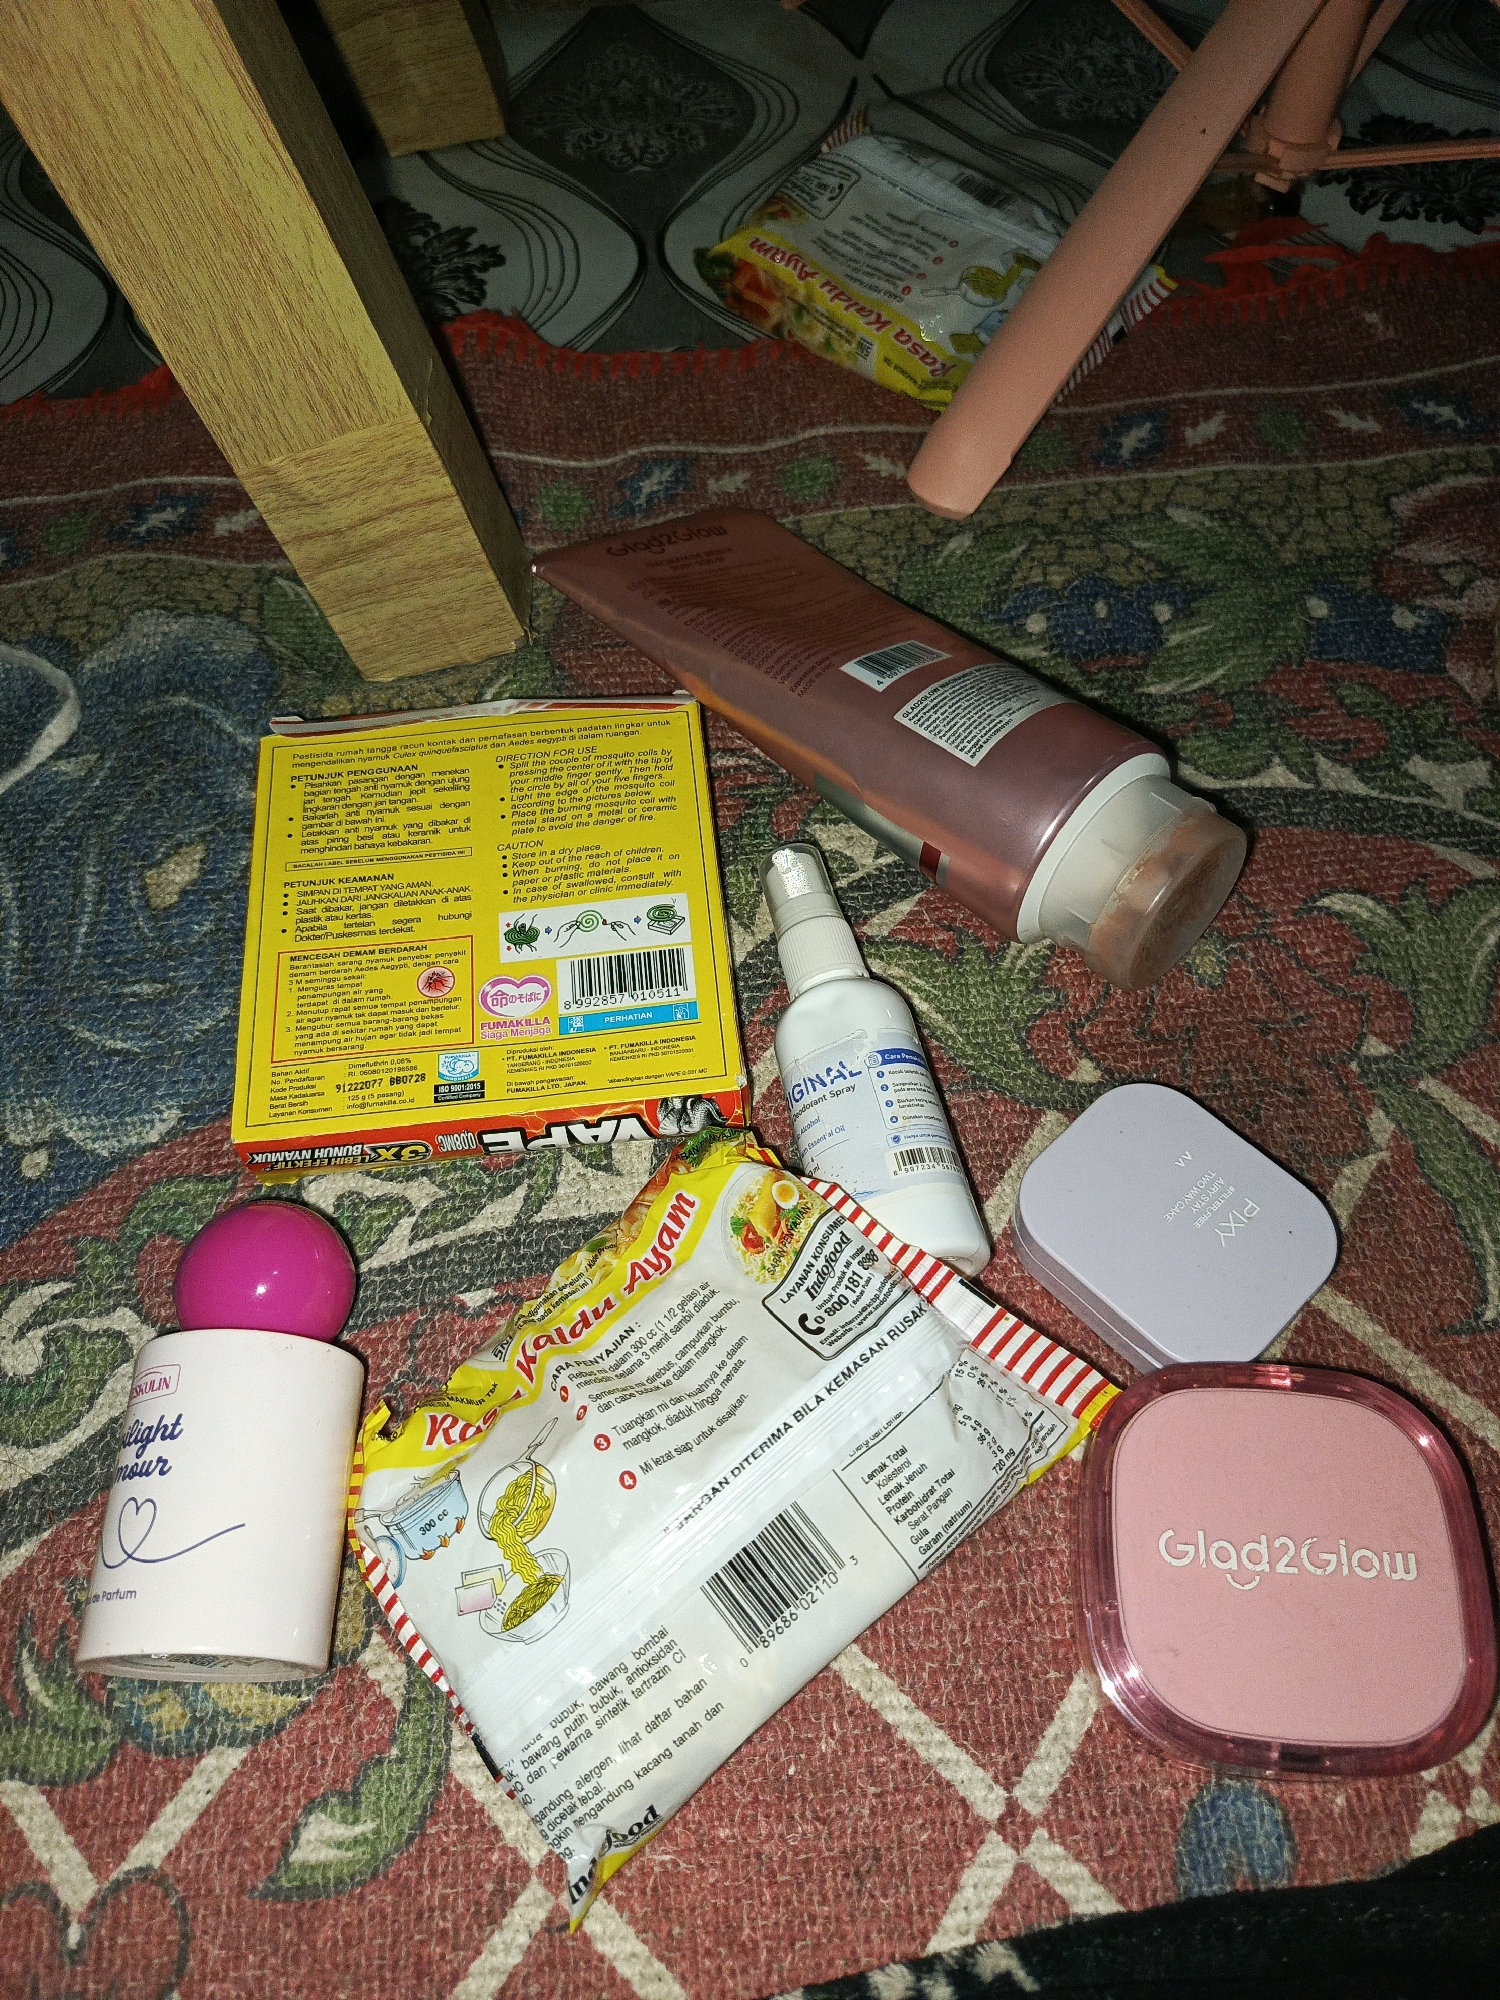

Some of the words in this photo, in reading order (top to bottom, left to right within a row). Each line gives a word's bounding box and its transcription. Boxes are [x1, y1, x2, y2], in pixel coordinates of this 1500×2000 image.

[496, 751, 550, 762] DIRECTION
[553, 748, 574, 756] FOR
[578, 746, 597, 754] USE
[510, 761, 529, 769] Split
[549, 756, 579, 764] couple
[594, 752, 634, 760] mosquito
[661, 748, 672, 756] by
[291, 771, 344, 782] PETUNJUK
[347, 764, 418, 778] PENGGUNAAN
[497, 840, 543, 851] CAUTION
[512, 851, 536, 860] Store
[559, 847, 573, 855] dry
[576, 844, 602, 854] place.
[284, 878, 335, 888] PETUNJUK
[338, 873, 394, 884] KEAMANAN
[290, 949, 341, 962] MENCEGAH
[342, 949, 376, 958] DEMAM
[378, 945, 427, 956] BERDARAH
[564, 1001, 570, 1010] 8
[576, 994, 625, 1008] 992857
[632, 988, 681, 1001] 010511
[480, 1017, 551, 1031] FUMAKILLA
[604, 1012, 653, 1023] PERHATIAN
[480, 1029, 508, 1040] Siaga
[511, 1026, 551, 1038] Menjaga
[520, 1051, 558, 1061] FUMAKILLA
[560, 1047, 596, 1057] INDONESIA
[438, 1084, 448, 1093] ISO
[450, 1082, 481, 1092] 9001:2015
[786, 1061, 862, 1112] IGINAL
[829, 1084, 856, 1098] Spray
[480, 1116, 652, 1154] VAPE
[835, 1125, 845, 1135] Oil
[253, 1151, 309, 1163] NYAMUK
[314, 1144, 363, 1158] BUNUH
[1198, 1170, 1216, 1190] TWO
[1208, 1176, 1225, 1196] AIRY
[1183, 1187, 1199, 1205] WAY
[1190, 1194, 1209, 1215] STAY
[1163, 1201, 1184, 1223] CAKE
[1214, 1198, 1261, 1247] PIXY
[624, 1192, 696, 1294] Ayam
[767, 1246, 787, 1276] SARAN
[804, 1230, 852, 1302] Indofood
[780, 1261, 815, 1304] LAYANAN
[825, 1294, 850, 1316] 800
[845, 1271, 864, 1294] 181
[516, 1296, 616, 1383] Kaldu
[568, 1370, 596, 1382] Rebus
[597, 1367, 608, 1375] mi
[608, 1351, 633, 1372] dalam
[630, 1336, 648, 1353] 300
[646, 1328, 658, 1340] cc
[663, 1307, 678, 1322] 1/2
[677, 1289, 701, 1315] gelas)
[700, 1281, 711, 1291] air
[576, 1375, 614, 1389] mendidih
[616, 1360, 645, 1380] selama
[642, 1352, 650, 1360] 3
[649, 1334, 672, 1357] menit
[669, 1310, 696, 1335] sambil
[693, 1289, 720, 1314] diaduk.
[551, 1361, 574, 1391] CARA
[575, 1326, 636, 1368] PENYAJIAN
[588, 1384, 635, 1402] Sementara
[645, 1359, 678, 1385] direbus,
[675, 1326, 712, 1362] campurkan
[712, 1298, 740, 1323] bumbu,
[611, 1409, 659, 1437] Tuangkan
[657, 1403, 670, 1413] mi
[669, 1393, 687, 1406] dan
[687, 1370, 720, 1397] kuahnya
[717, 1360, 728, 1372] ke
[726, 1334, 749, 1364] dalam
[730, 1421, 793, 1479] DITERIMA
[792, 1394, 826, 1423] BILA
[824, 1338, 889, 1396] KEMASAN
[887, 1302, 928, 1342] RUSAK
[639, 1461, 653, 1475] Mi
[653, 1449, 675, 1467] lezat
[675, 1437, 693, 1456] siap
[693, 1426, 717, 1445] untuk
[716, 1394, 749, 1426] disajikan.
[117, 1456, 172, 1482] mour
[861, 1459, 888, 1485] Lemak
[886, 1445, 908, 1466] Total
[875, 1459, 912, 1490] Kolesterol
[992, 1458, 1007, 1474] 720
[1004, 1448, 1016, 1463] mg
[878, 1480, 905, 1506] Lemak
[903, 1462, 928, 1486] Jenuh
[894, 1484, 938, 1525] Karbohidrat
[934, 1468, 956, 1488] Total
[886, 1491, 915, 1515] Protein
[908, 1511, 929, 1530] Serat
[928, 1487, 953, 1514] Pangan
[419, 1520, 436, 1536] 300
[437, 1509, 449, 1522] cc
[910, 1528, 930, 1546] Gula
[918, 1531, 943, 1556] Garam
[942, 1499, 973, 1534] (natrium)
[1158, 1528, 1418, 1590] Glad2Glow
[102, 1589, 137, 1601] Parfum
[759, 1609, 799, 1648] 89686
[799, 1571, 839, 1610] 02110
[631, 1625, 669, 1661] bombai
[589, 1685, 623, 1714] bubuk,
[626, 1638, 678, 1685] antioksidan
[595, 1697, 631, 1729] sintetik
[631, 1664, 672, 1699] tartrazin
[618, 1732, 643, 1755] lihat
[644, 1706, 673, 1734] daftar
[674, 1677, 708, 1709] bahan
[633, 1748, 673, 1780] kacang
[673, 1720, 702, 1748] tanah
[704, 1701, 724, 1722] dan
